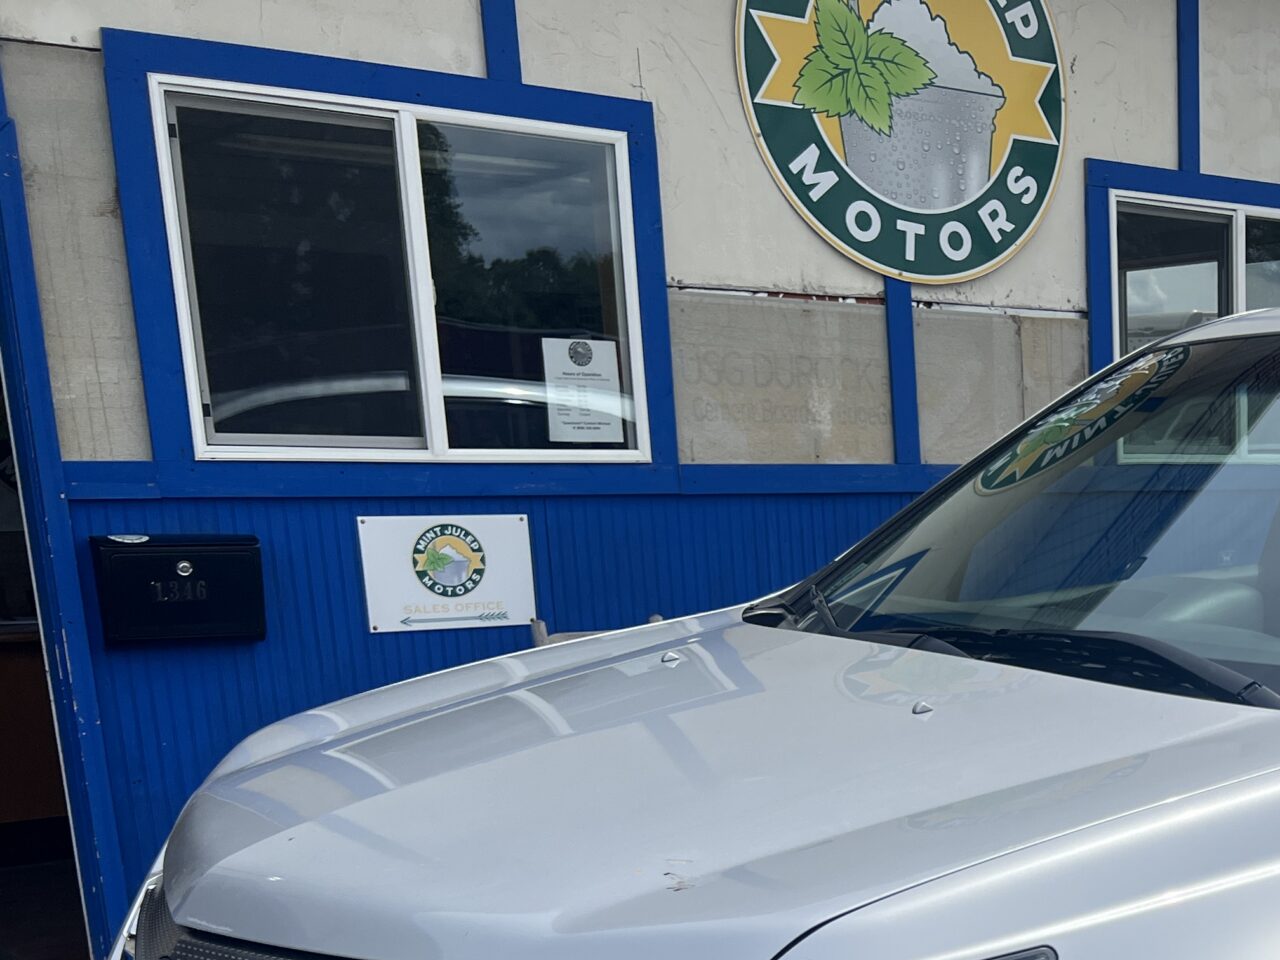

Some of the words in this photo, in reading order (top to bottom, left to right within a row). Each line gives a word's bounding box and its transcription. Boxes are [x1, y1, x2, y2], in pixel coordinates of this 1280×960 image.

[788, 144, 1038, 261] MOTORS
[416, 526, 441, 551] MINT
[444, 526, 479, 551] JULEP
[422, 572, 481, 596] MOTORS
[403, 604, 450, 615] SALES
[455, 601, 505, 612] OFFICE
